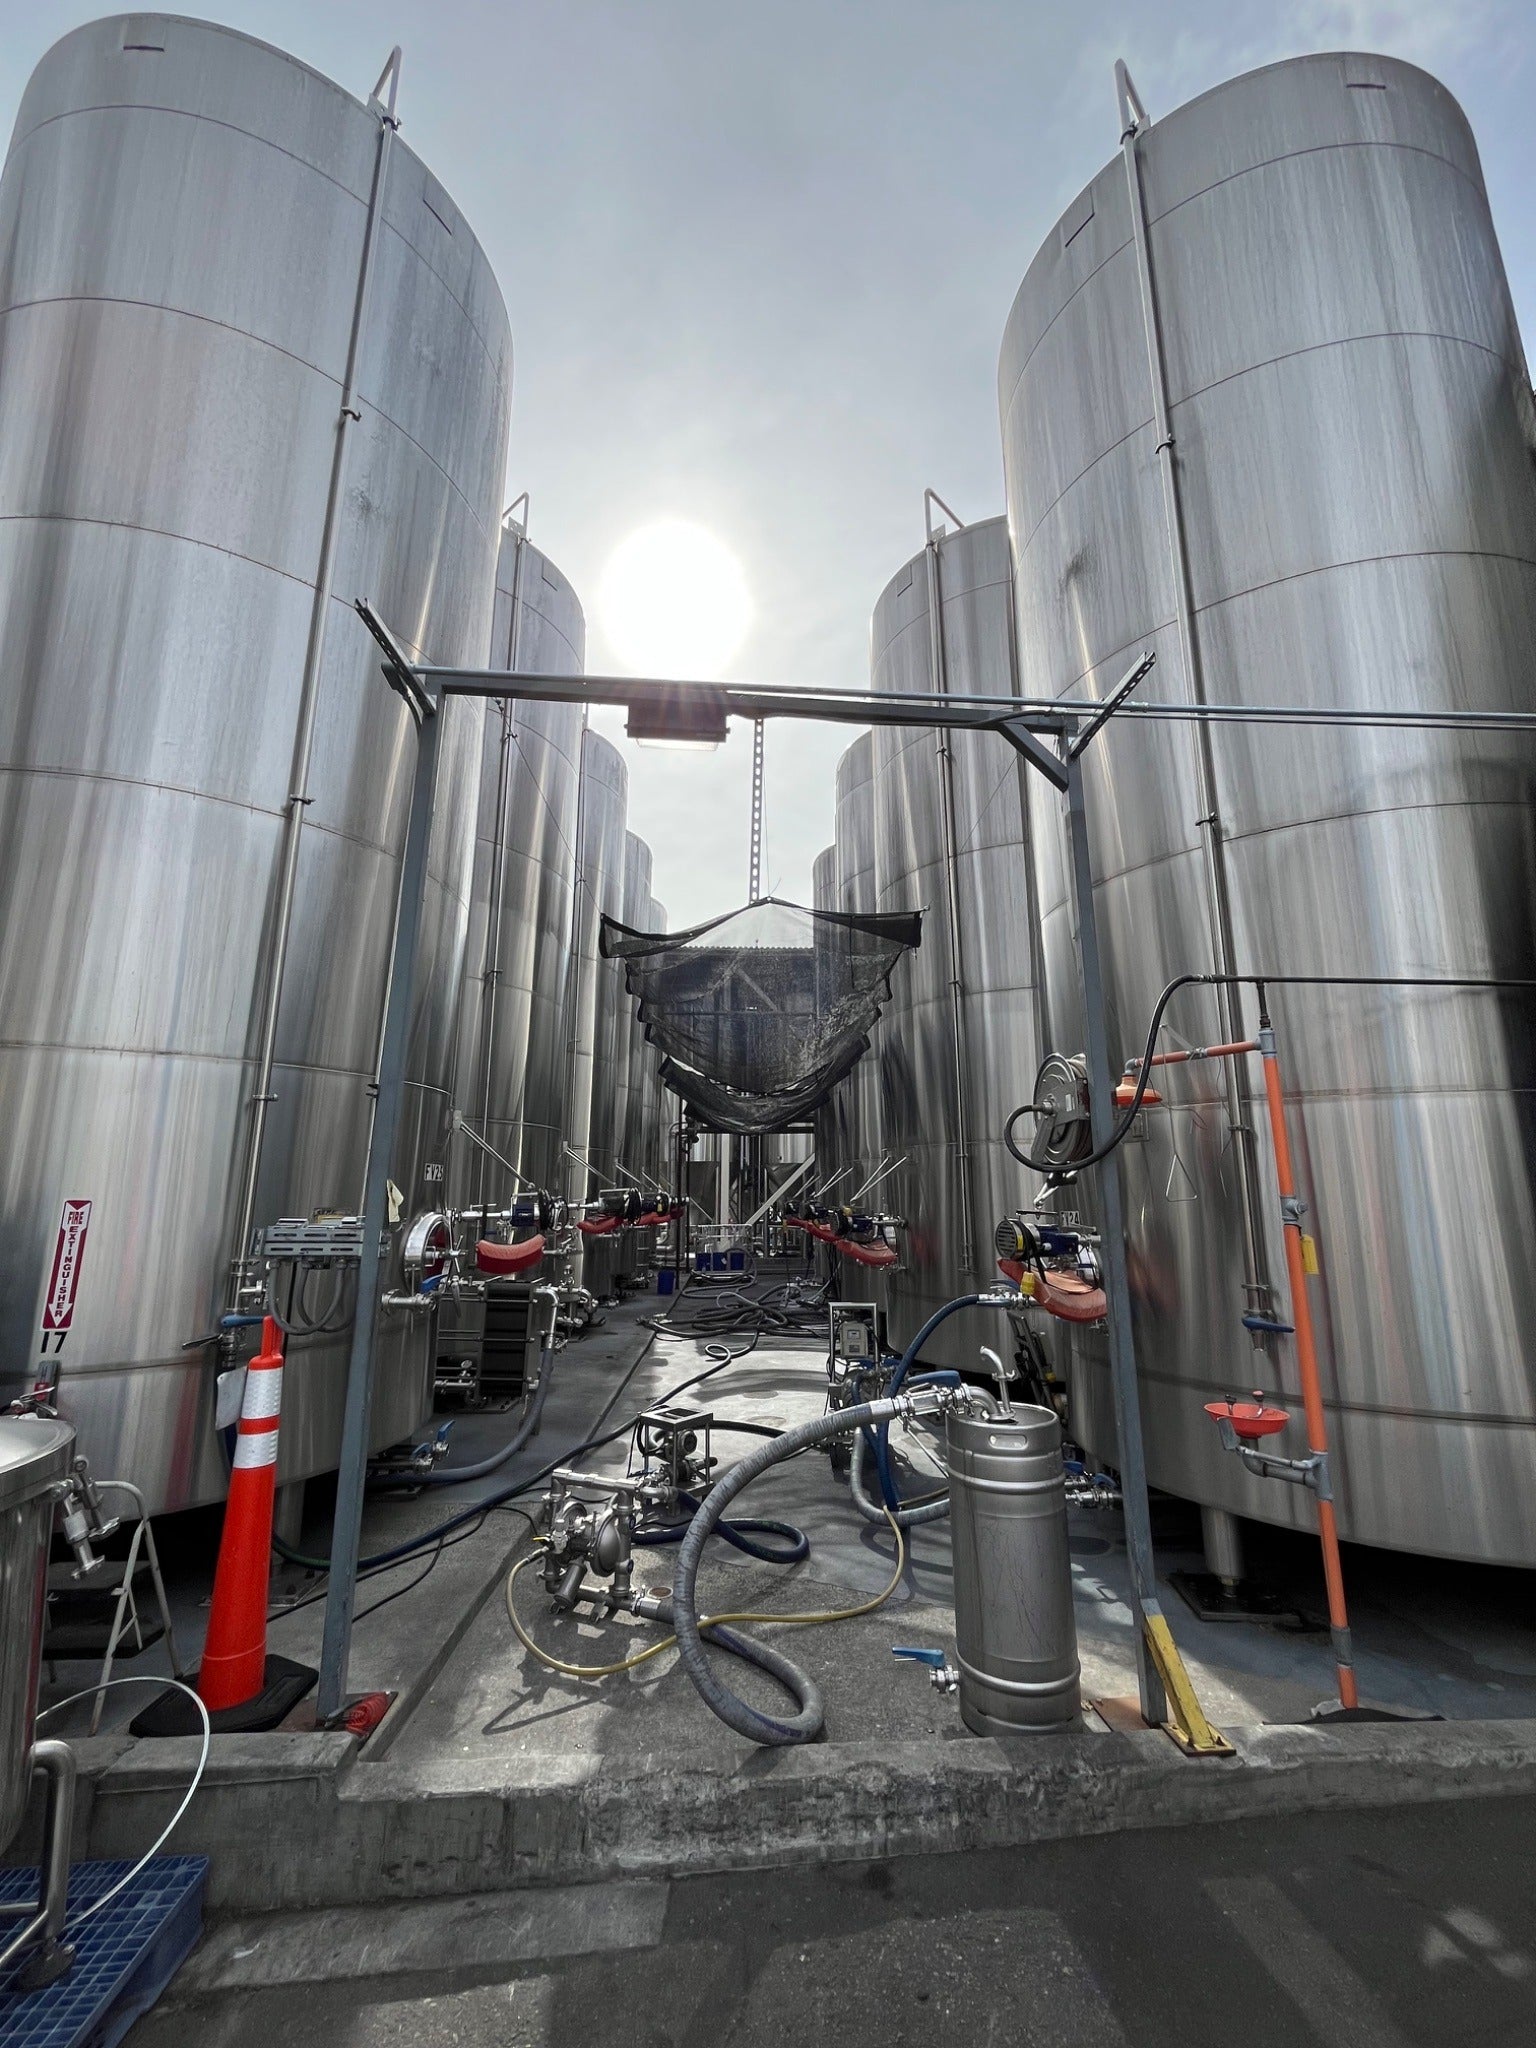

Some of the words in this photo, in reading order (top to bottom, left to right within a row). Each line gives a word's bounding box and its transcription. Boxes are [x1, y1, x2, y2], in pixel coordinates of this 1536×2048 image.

[67, 1211, 84, 1224] FIRE
[54, 1225, 79, 1317] EXTINGUISHER
[40, 1331, 68, 1353] 17
